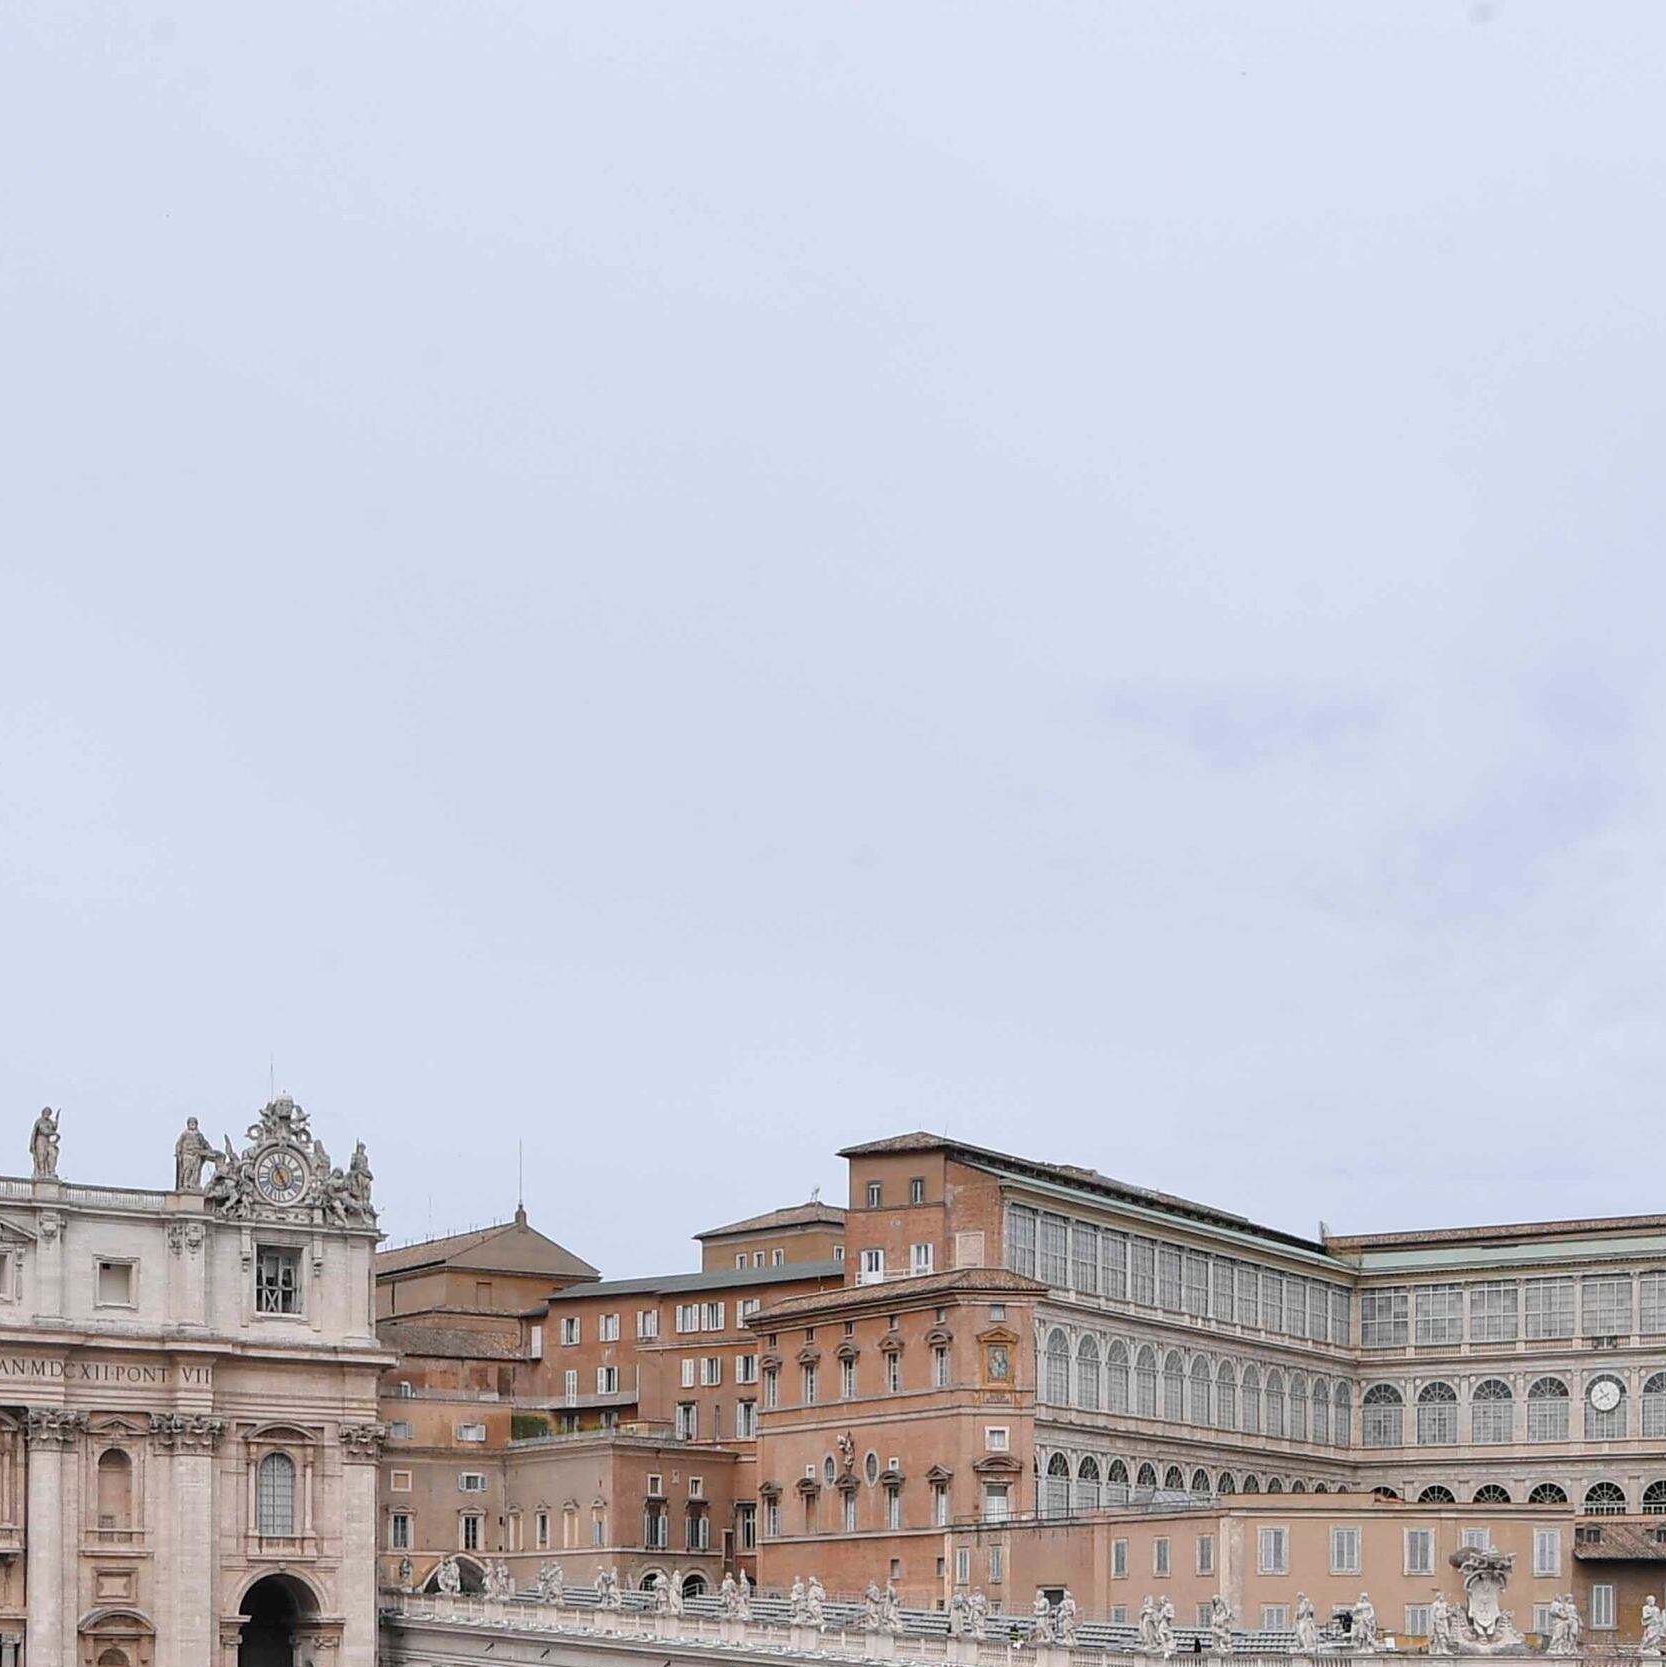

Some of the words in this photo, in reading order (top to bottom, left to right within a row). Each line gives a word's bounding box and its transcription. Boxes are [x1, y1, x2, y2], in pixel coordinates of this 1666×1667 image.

[30, 1359, 108, 1381] MDCXII
[116, 1365, 169, 1383] PONT
[181, 1367, 210, 1385] VII
